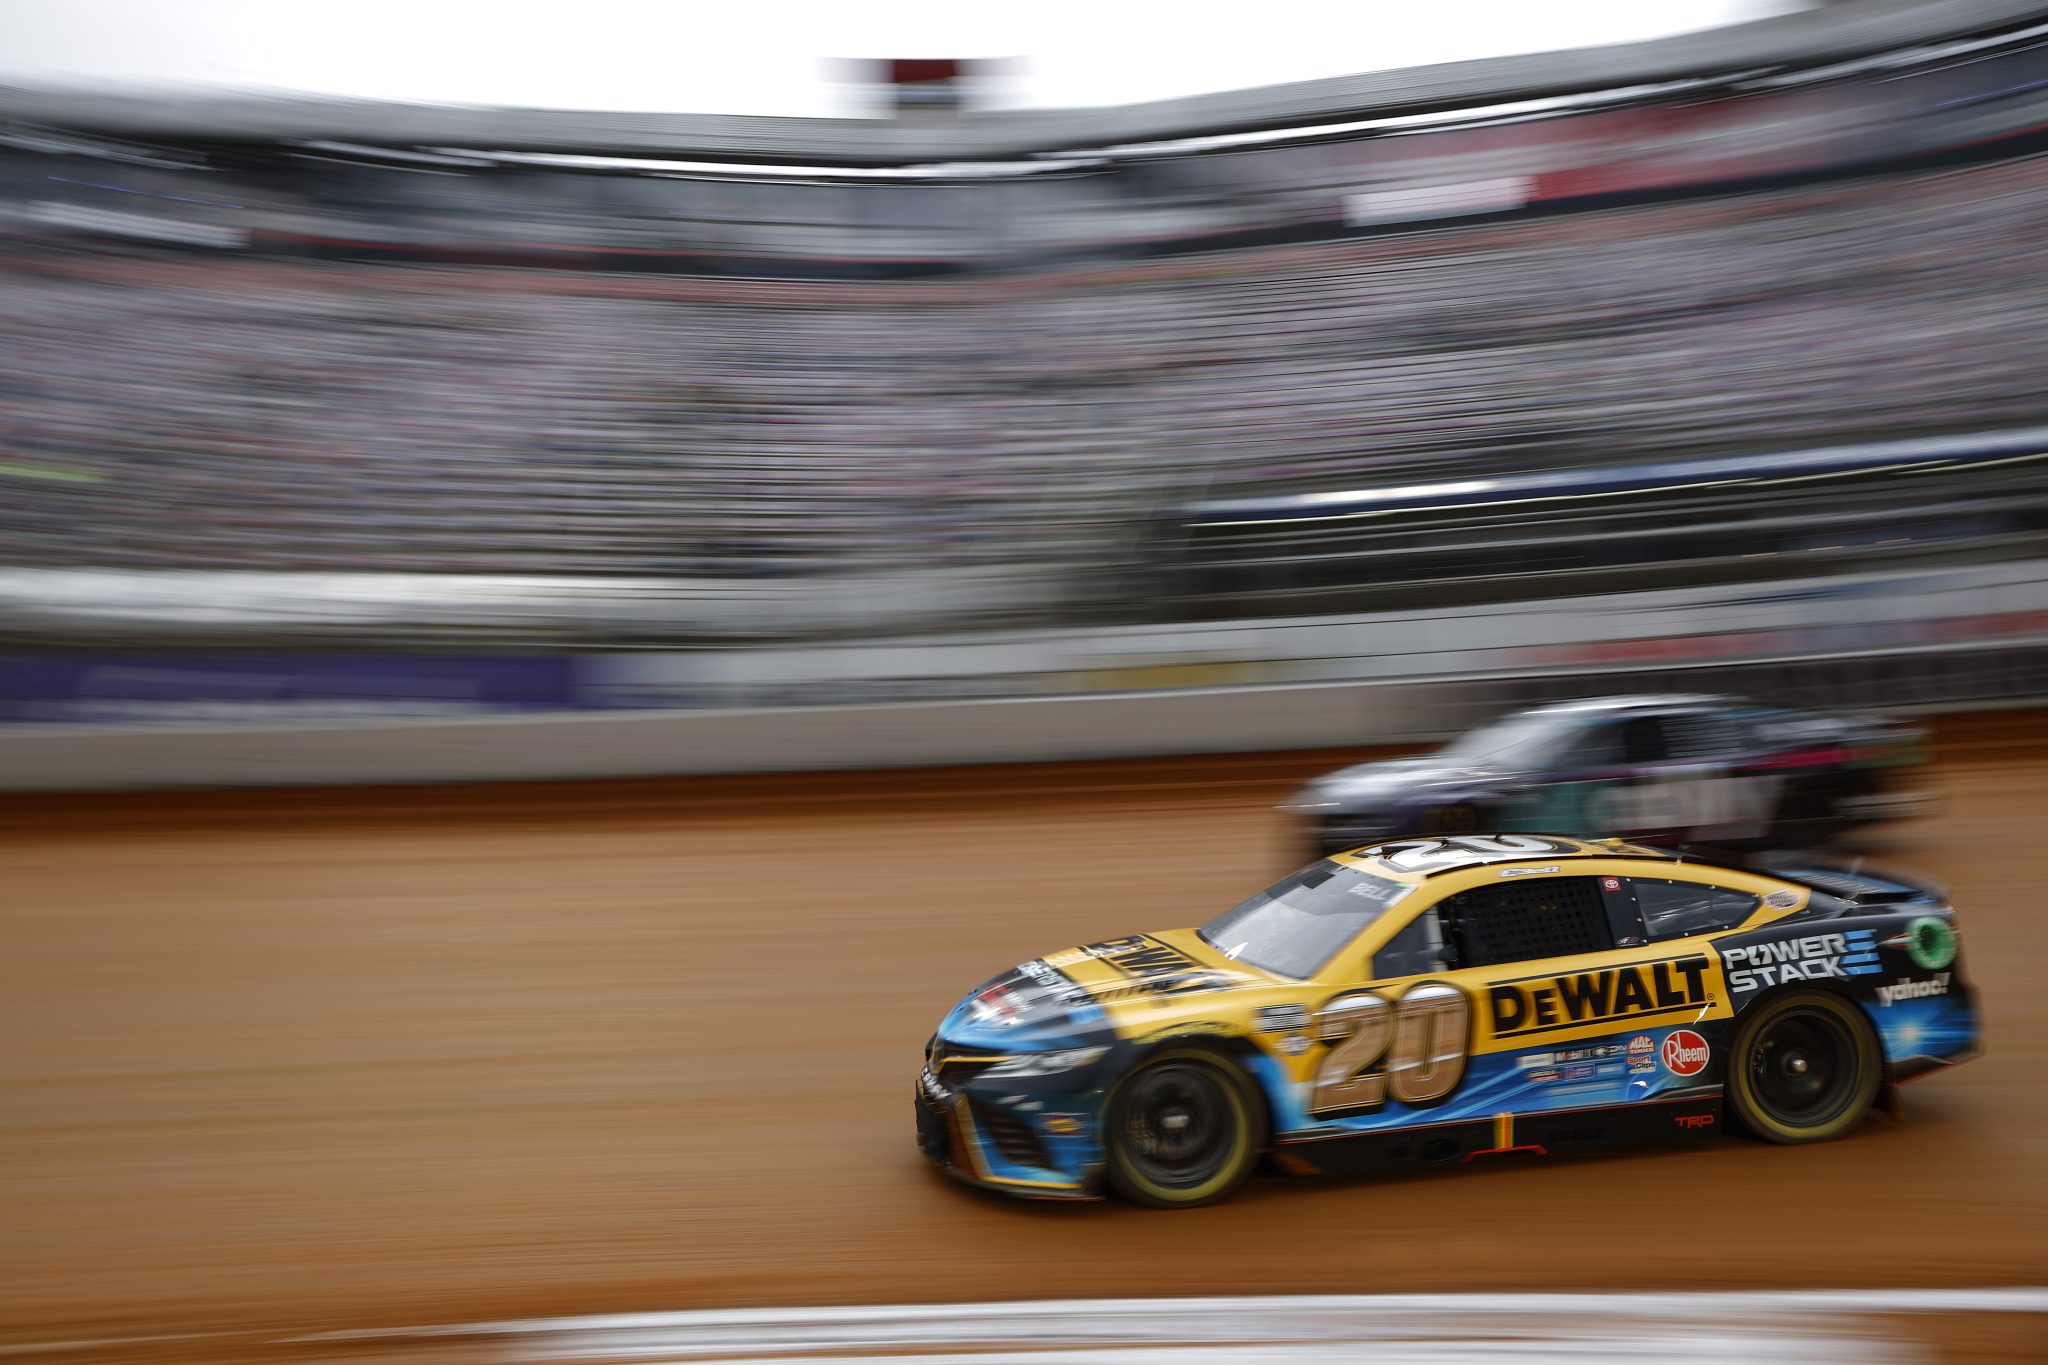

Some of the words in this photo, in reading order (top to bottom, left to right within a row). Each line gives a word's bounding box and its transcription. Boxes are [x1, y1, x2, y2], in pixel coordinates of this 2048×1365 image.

[1348, 882, 1392, 900] BELL
[1729, 954, 1849, 993] STACK
[1876, 971, 1951, 1008] yahoo!
[1308, 980, 1473, 1121] 20
[1628, 1056, 1651, 1064] Sport
[1667, 1033, 1707, 1068] Rheem
[1636, 1061, 1656, 1069] Clips
[1674, 1114, 1714, 1128] TRD
